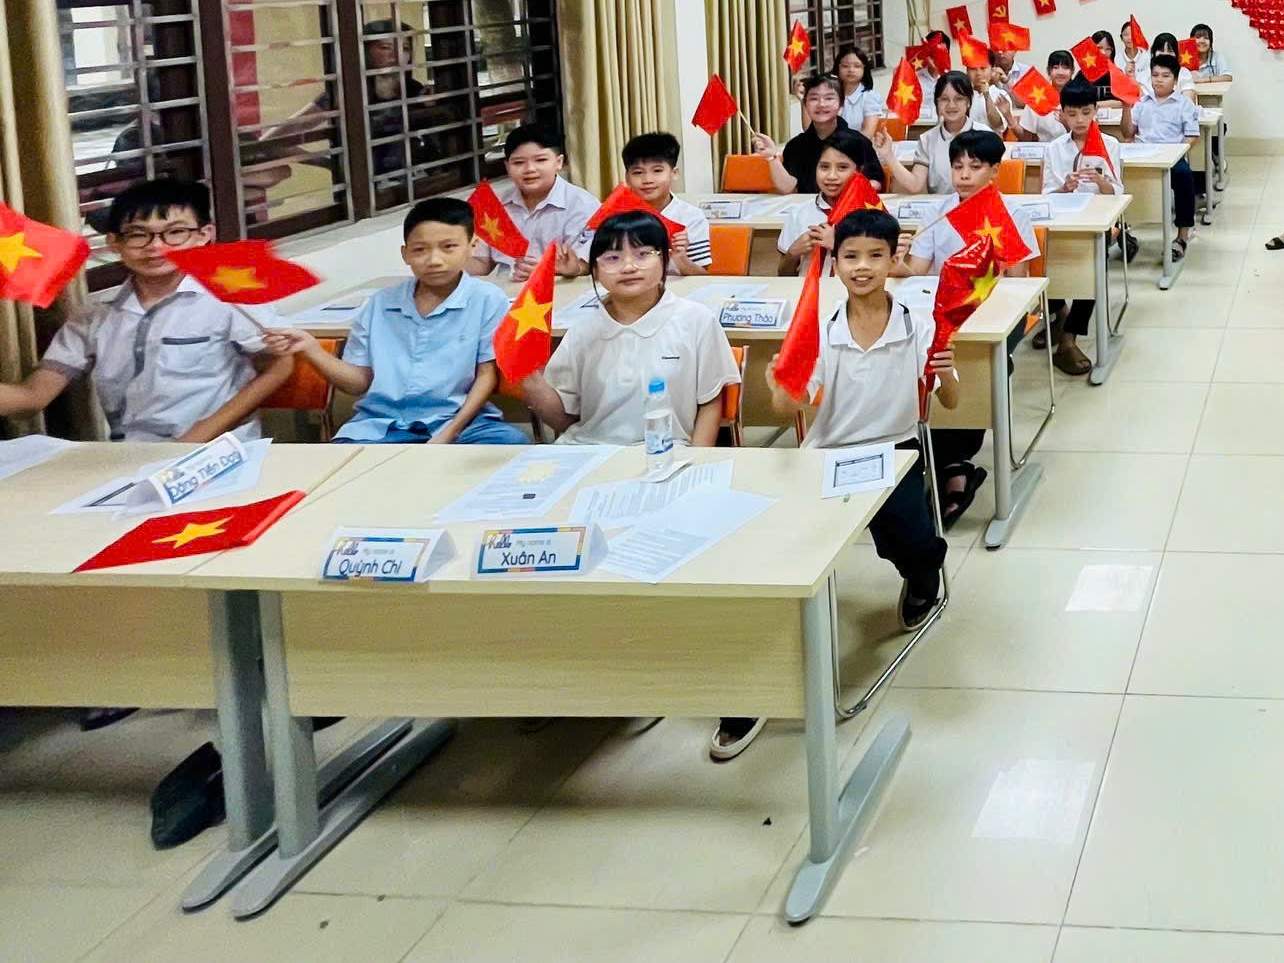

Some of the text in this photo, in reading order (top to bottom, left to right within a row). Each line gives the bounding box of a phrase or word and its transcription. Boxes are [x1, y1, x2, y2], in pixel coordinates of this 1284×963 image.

[501, 550, 556, 566] Xuân An
[381, 559, 403, 574] Chi
